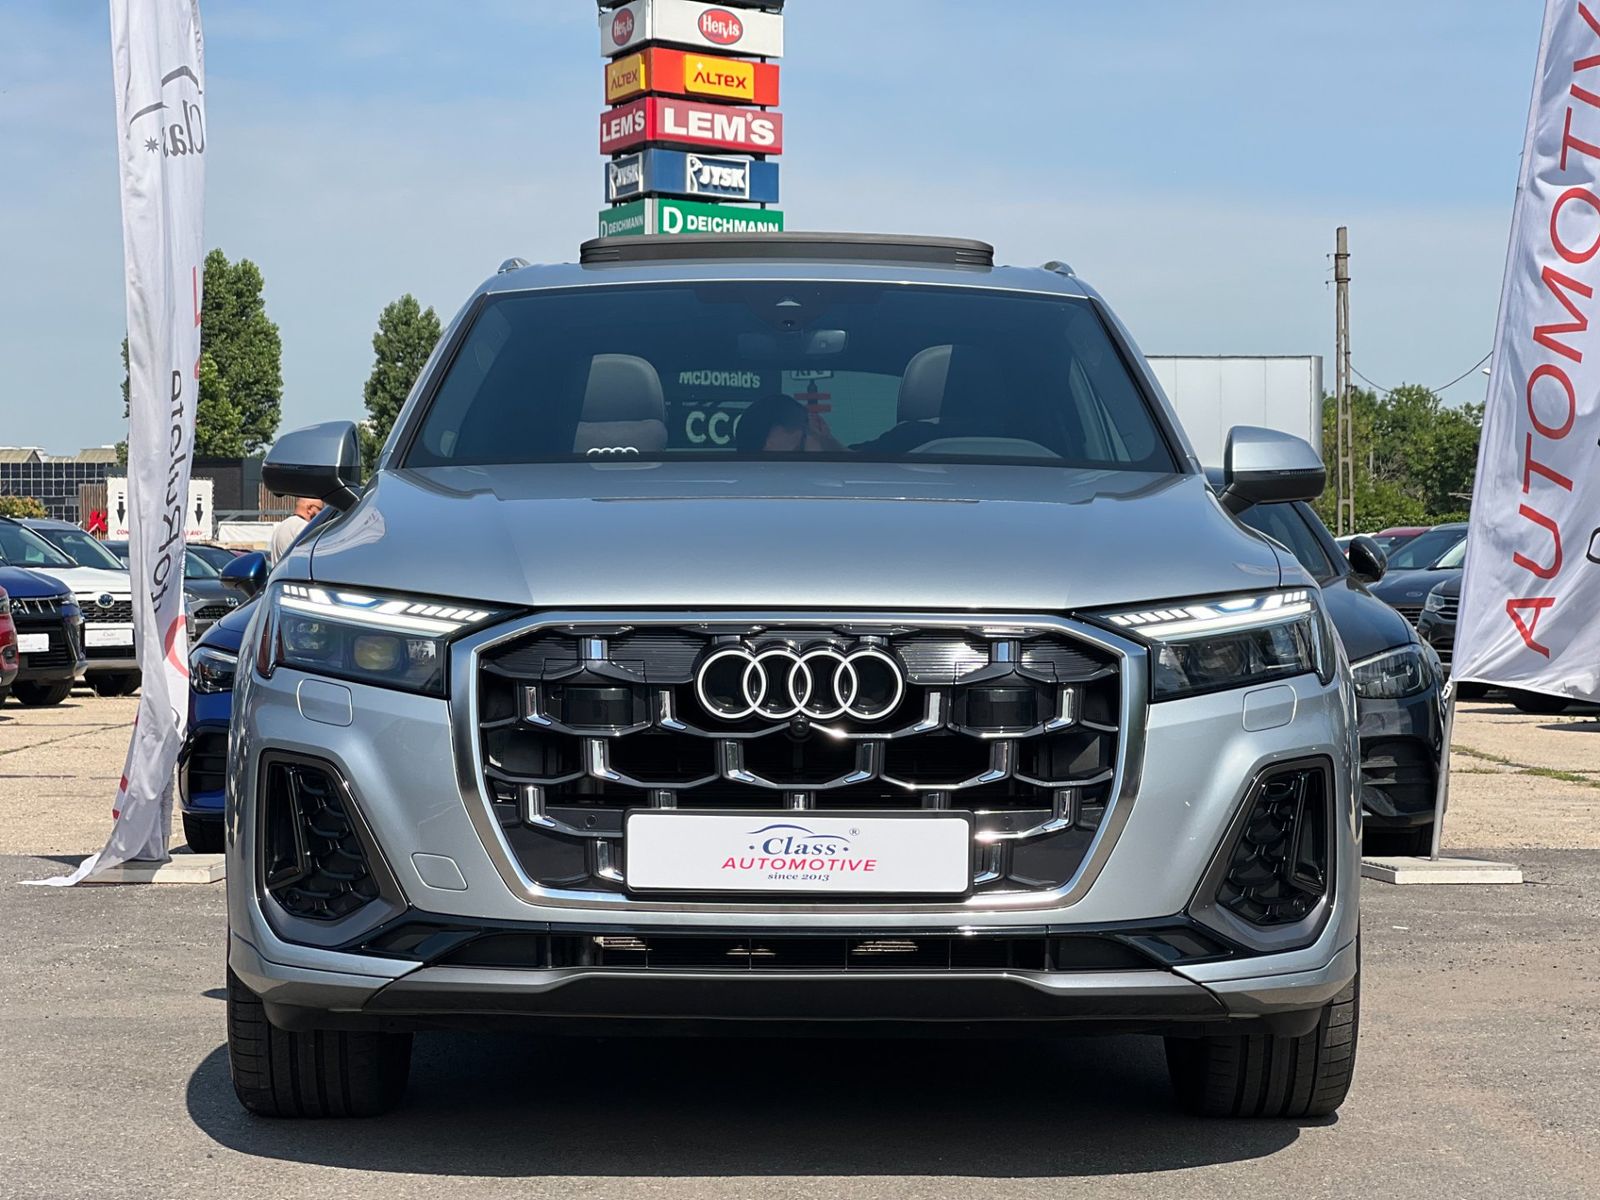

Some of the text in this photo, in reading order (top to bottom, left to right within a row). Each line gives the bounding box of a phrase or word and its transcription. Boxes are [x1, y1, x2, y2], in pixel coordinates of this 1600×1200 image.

[703, 14, 740, 38] Hervis
[602, 109, 645, 143] LEM'S
[664, 107, 775, 146] LEM'S
[699, 164, 746, 190] JYSK
[687, 215, 779, 233] DEICHMANN
[679, 370, 761, 389] McDonald's
[685, 410, 743, 445] CC
[762, 836, 837, 855] Class
[721, 857, 878, 872] AUTOMOTIVE
[768, 872, 830, 882] since 2013
